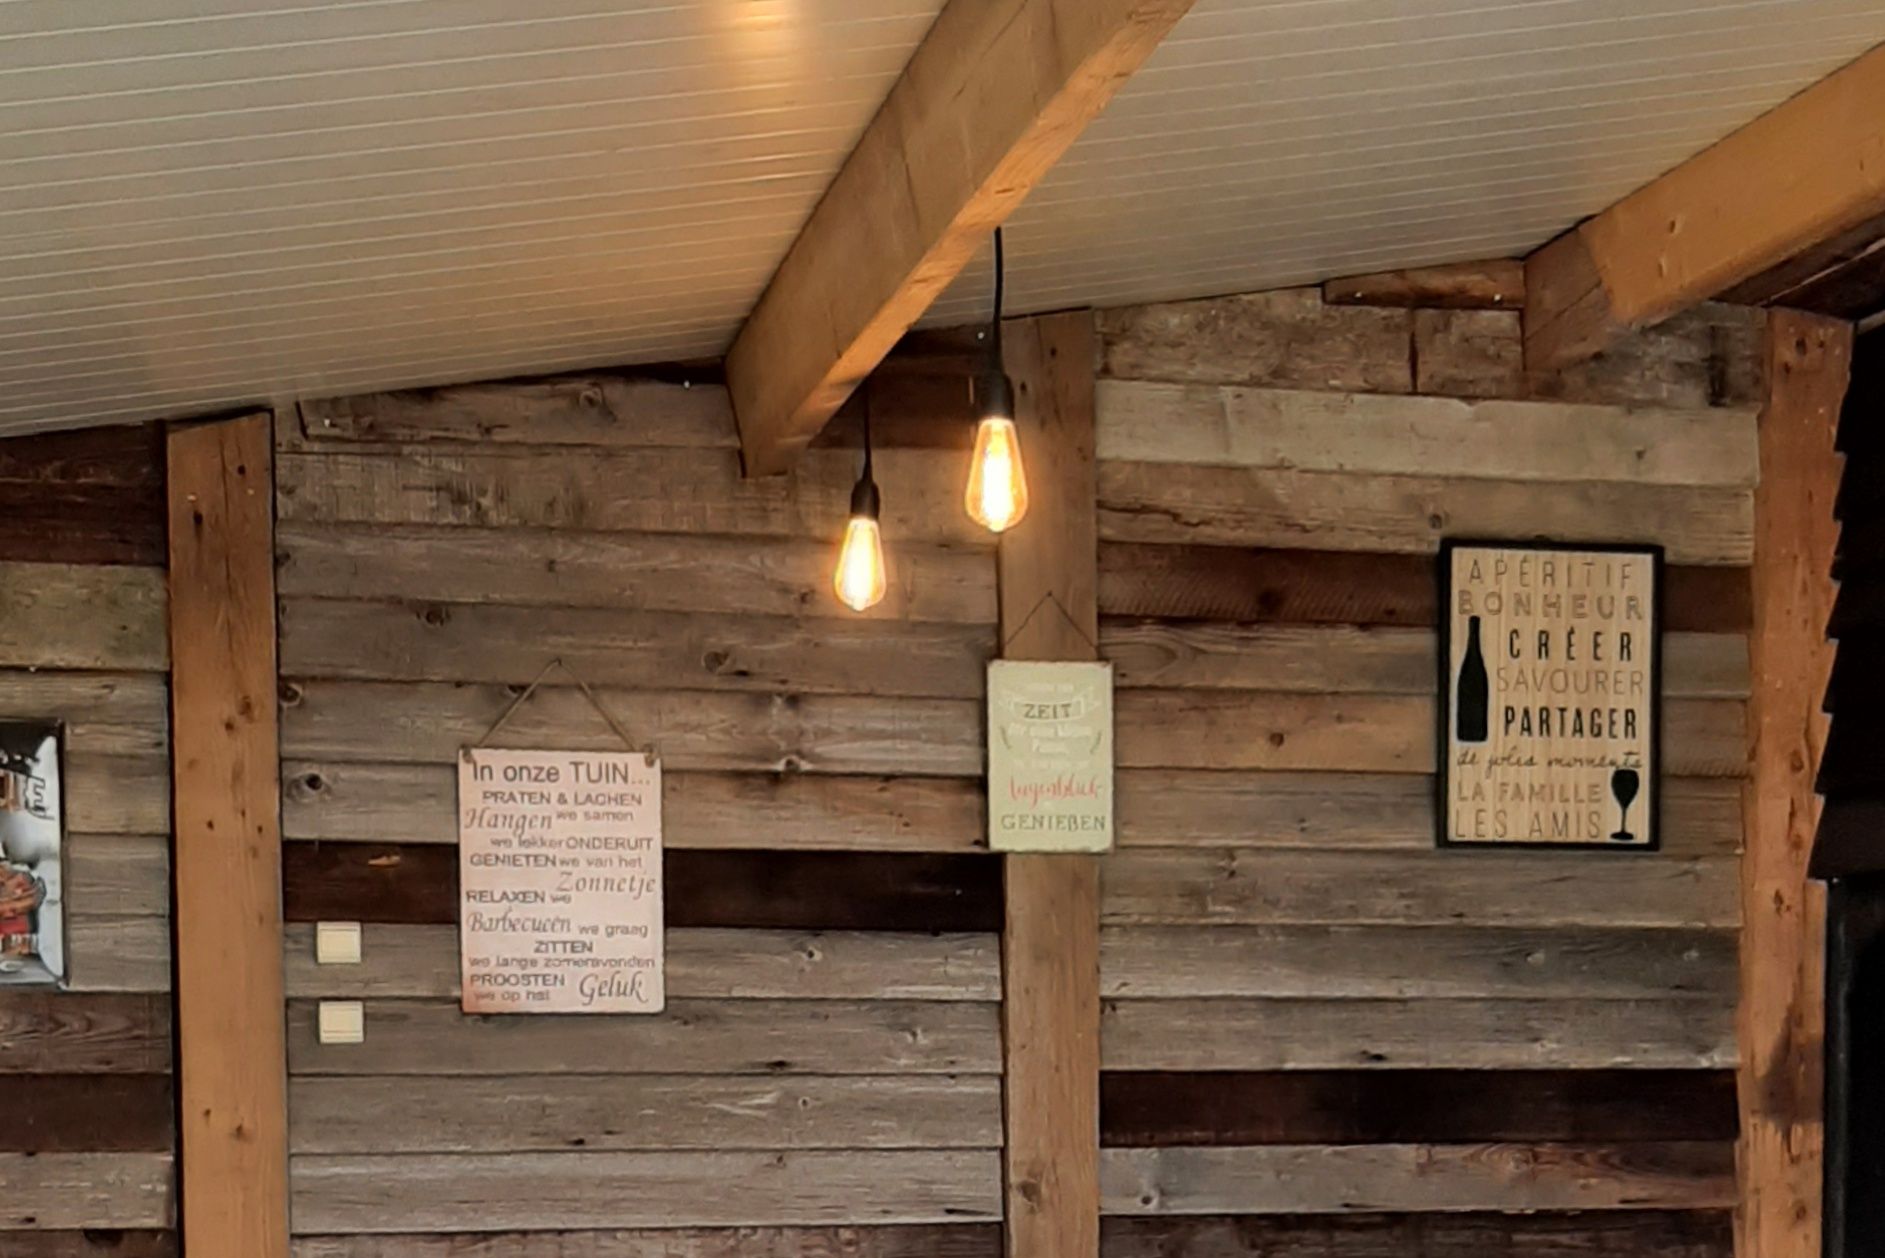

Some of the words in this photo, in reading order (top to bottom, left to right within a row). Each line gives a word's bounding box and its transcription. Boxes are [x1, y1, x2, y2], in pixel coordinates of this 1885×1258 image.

[1468, 557, 1633, 589] APÉRITIF
[1457, 590, 1644, 621] BONHEUR
[1508, 626, 1633, 662] CRÉER
[1495, 667, 1645, 695] SAVOURER
[1024, 703, 1072, 720] ZEIT
[1503, 705, 1637, 739] PARTAGER
[472, 761, 493, 781] In
[503, 764, 560, 783] onze
[482, 791, 550, 806] PRATEN
[556, 793, 568, 805] &
[574, 794, 642, 806] LACHEN
[1457, 782, 1485, 801] LA
[1500, 783, 1602, 804] FAMILLE
[464, 806, 552, 838] Hangen
[1455, 808, 1508, 838] LES
[1529, 811, 1602, 840] AMIS
[565, 836, 653, 850] ONDERUIT
[469, 853, 557, 868] GENIETEN
[559, 858, 579, 868] we
[586, 857, 613, 868] van
[465, 890, 545, 904] RELAXEN
[533, 940, 594, 954] ZITTEN
[470, 973, 566, 987] PROOSTEN
[578, 969, 650, 1006] Geluk
